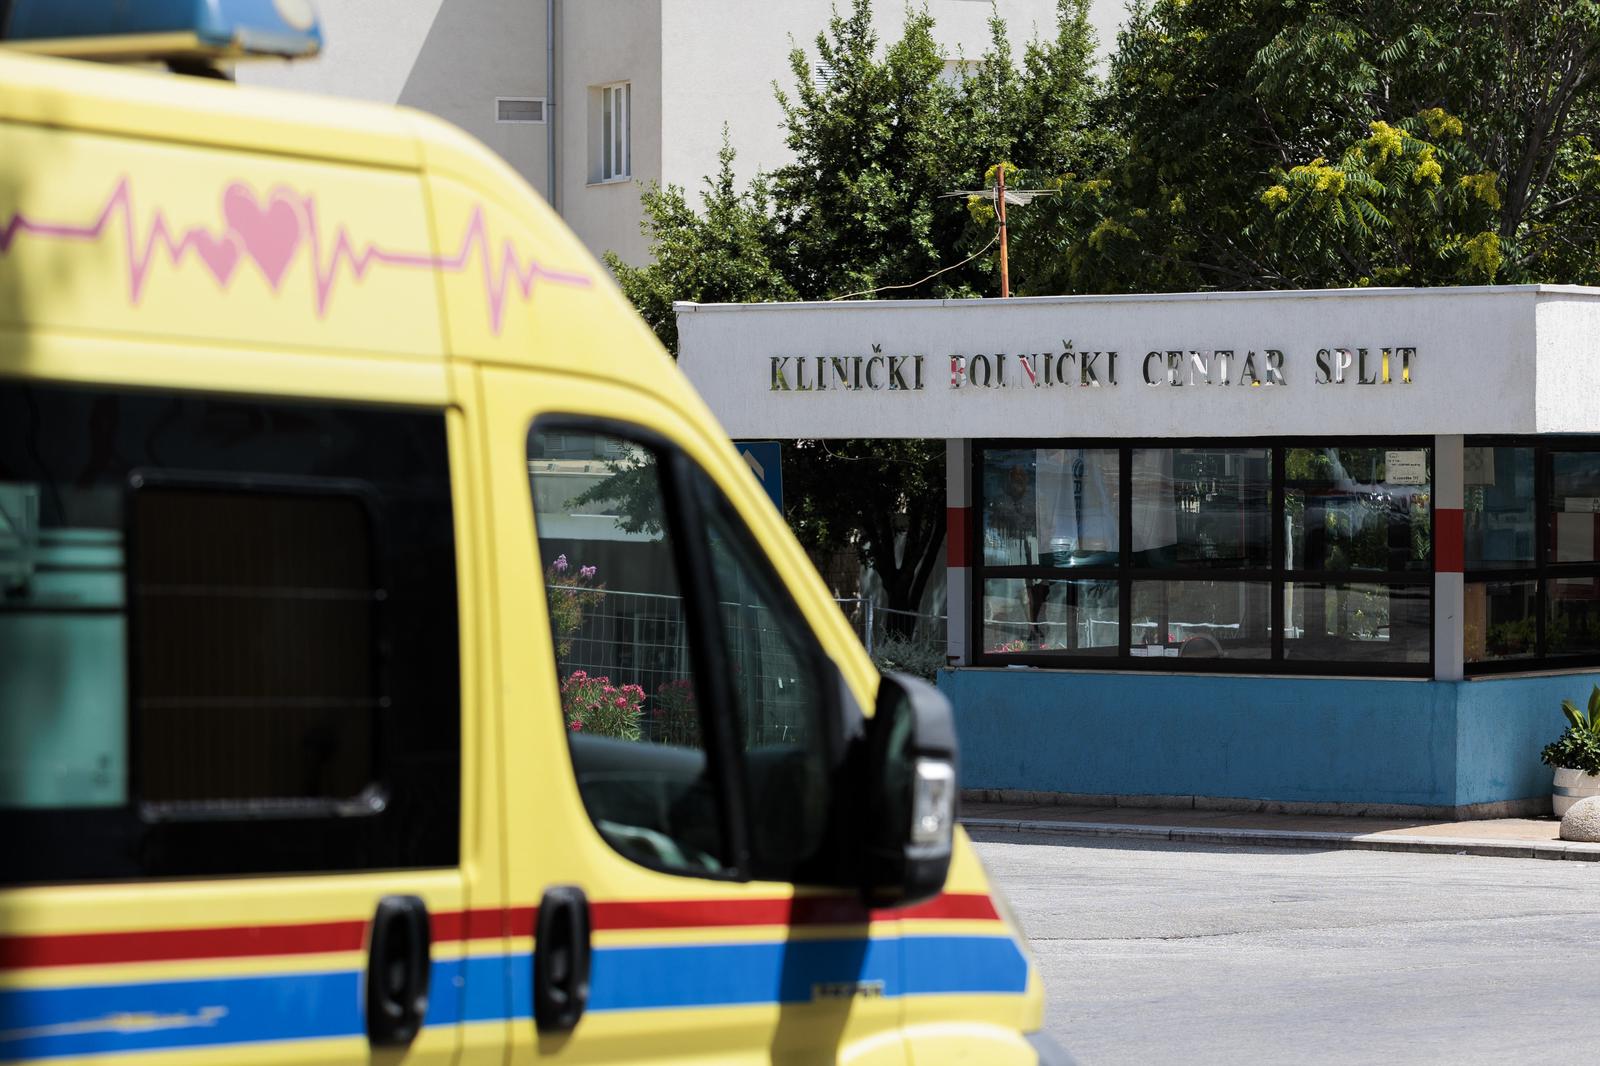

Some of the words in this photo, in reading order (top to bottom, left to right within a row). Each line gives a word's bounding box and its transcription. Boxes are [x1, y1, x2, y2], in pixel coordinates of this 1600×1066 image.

[769, 344, 925, 391] KLINIČKI
[1142, 349, 1288, 387] CENTAR
[1315, 347, 1417, 385] SPLIT
